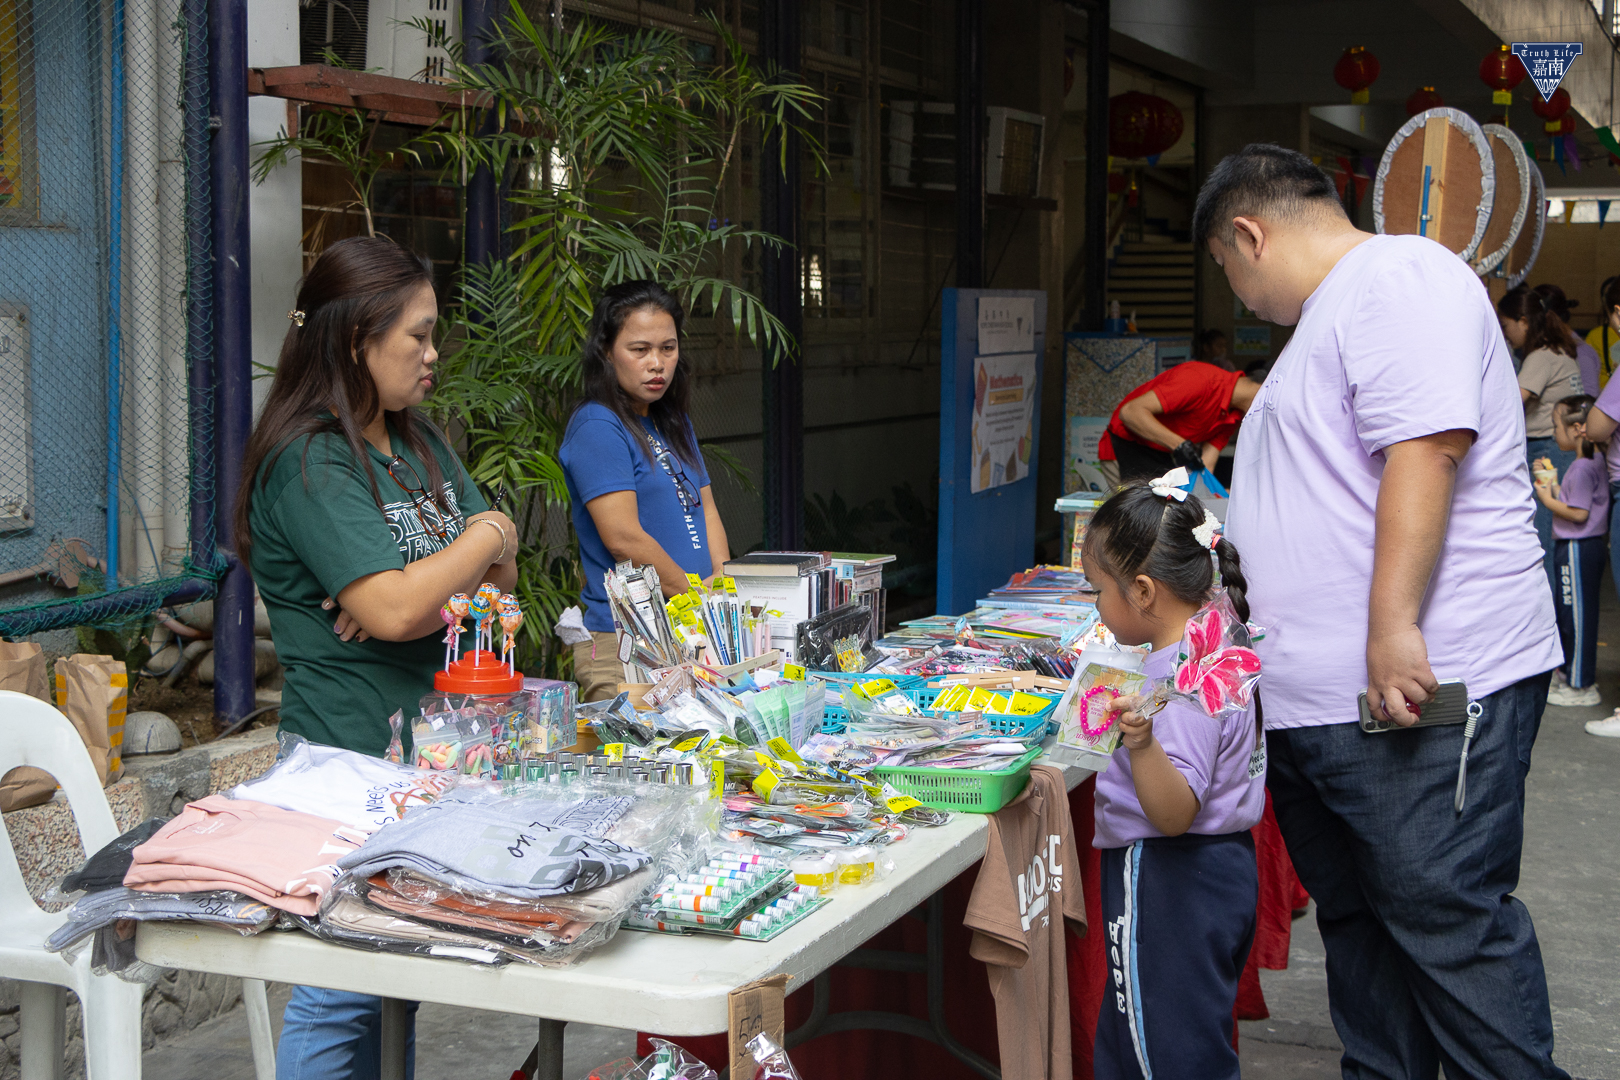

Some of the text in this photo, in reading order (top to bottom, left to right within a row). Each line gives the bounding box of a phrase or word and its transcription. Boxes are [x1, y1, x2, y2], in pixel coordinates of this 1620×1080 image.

[684, 515, 702, 550] FAITH
[1560, 564, 1573, 606] HOPE
[1076, 733, 1101, 747] Chosen
[1108, 921, 1126, 1014] HOPE
